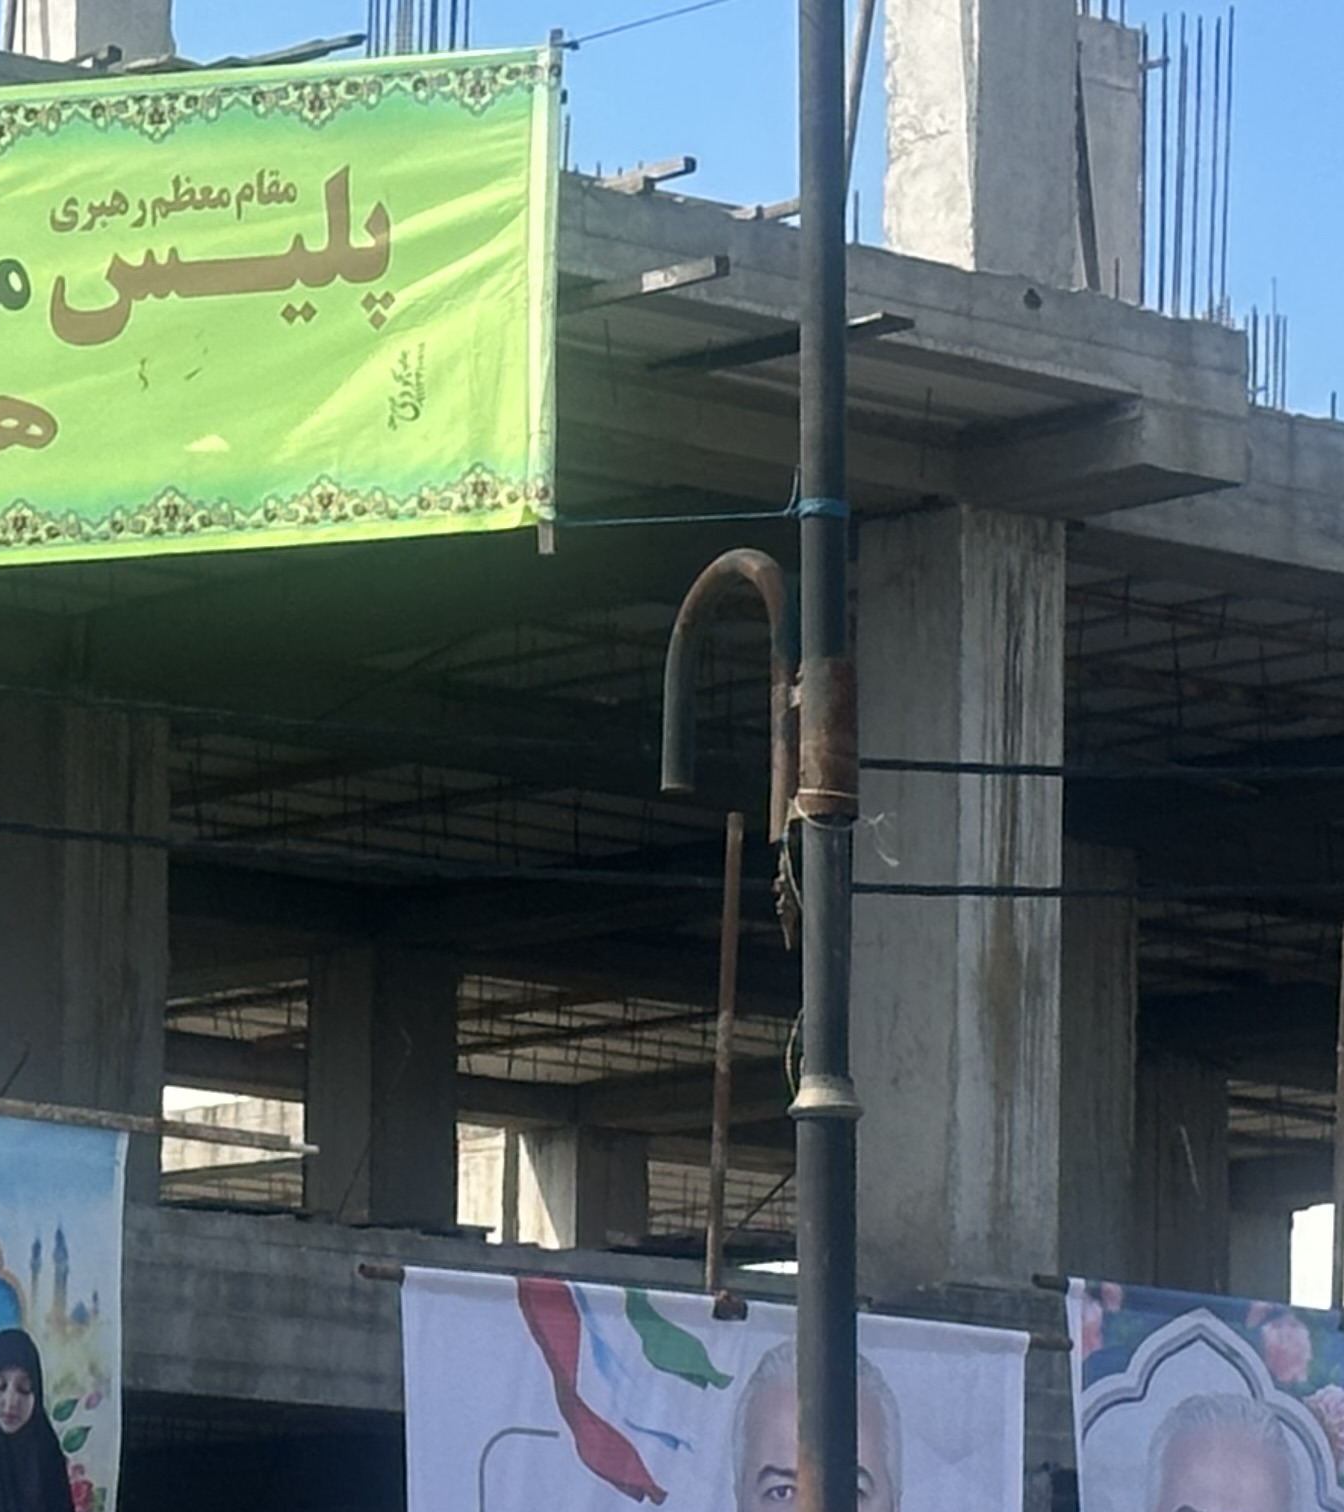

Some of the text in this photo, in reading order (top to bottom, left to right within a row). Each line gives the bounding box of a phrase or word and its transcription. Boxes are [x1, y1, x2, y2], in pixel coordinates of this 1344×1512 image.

[50, 167, 297, 234] مقام معظم رهبری
[50, 165, 395, 346] پلیس
